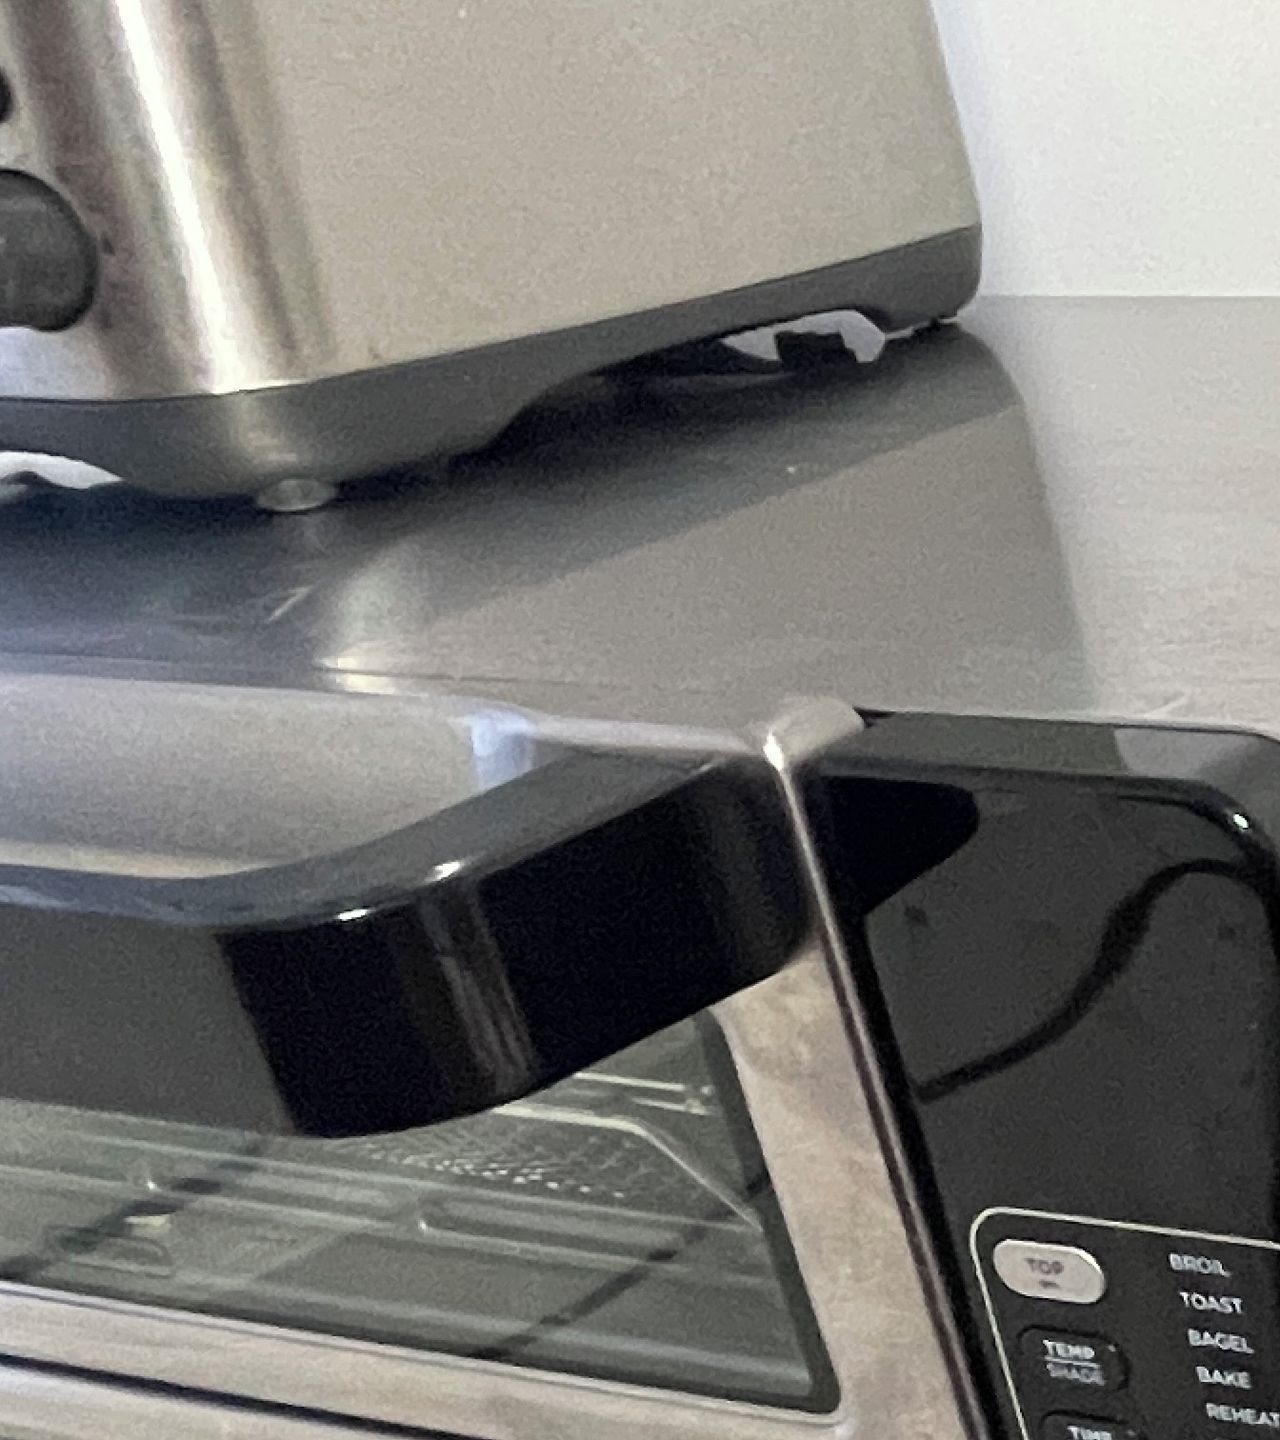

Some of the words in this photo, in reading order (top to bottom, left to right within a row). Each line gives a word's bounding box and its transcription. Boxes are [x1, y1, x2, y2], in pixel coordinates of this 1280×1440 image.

[1169, 1252, 1232, 1277] BROIL
[1178, 1290, 1243, 1315] TOAST
[1042, 1338, 1096, 1360] TEMP
[1187, 1327, 1255, 1354] BAGEL
[1195, 1365, 1252, 1389] BAKE
